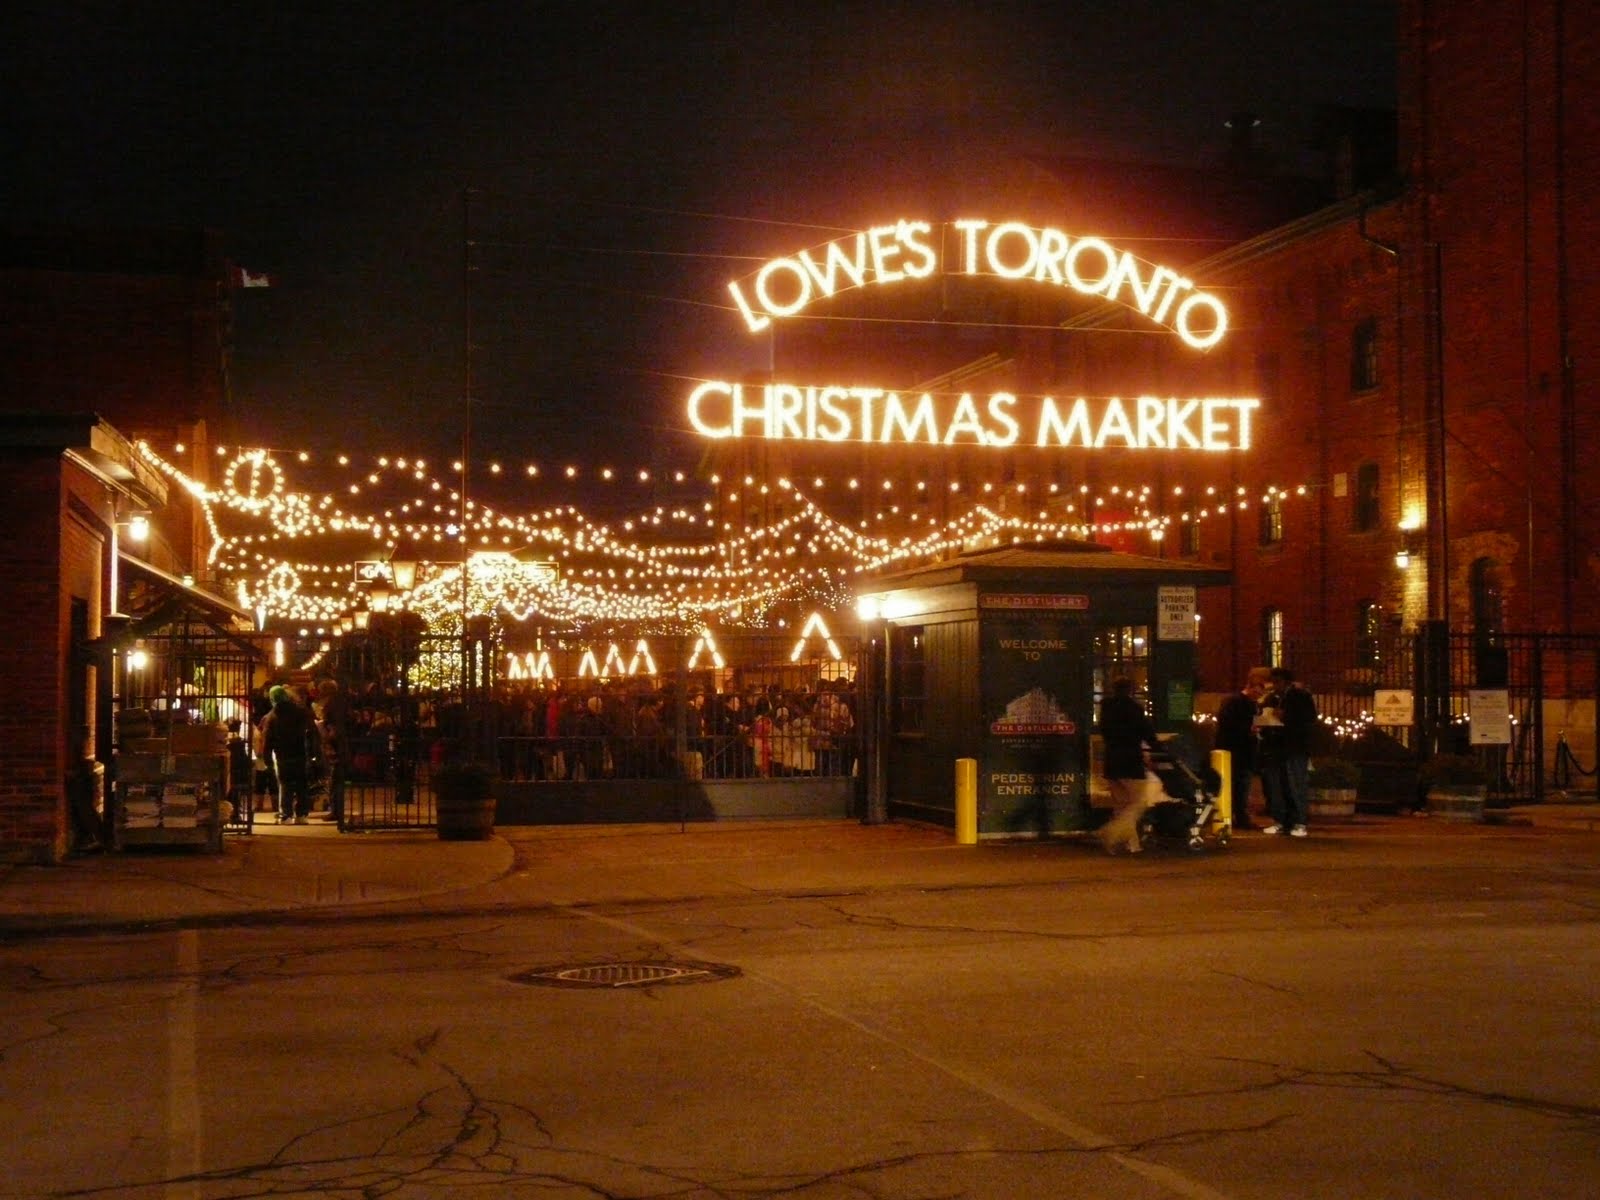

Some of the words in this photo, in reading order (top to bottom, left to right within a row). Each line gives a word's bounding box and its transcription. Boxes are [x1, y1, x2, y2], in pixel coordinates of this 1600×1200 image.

[954, 219, 1229, 350] TORONTO
[687, 381, 1020, 447] CHRISTMAS
[1036, 396, 1261, 451] MARKET
[986, 596, 1010, 605] THE
[1013, 596, 1083, 606] DISTILLERY
[1165, 604, 1189, 612] PARKING
[999, 639, 1068, 649] WELCOME
[1023, 651, 1041, 661] TO
[996, 724, 1013, 732] THE
[1016, 724, 1071, 732] DISTILLERY
[991, 773, 1075, 784] PEDESRIAN
